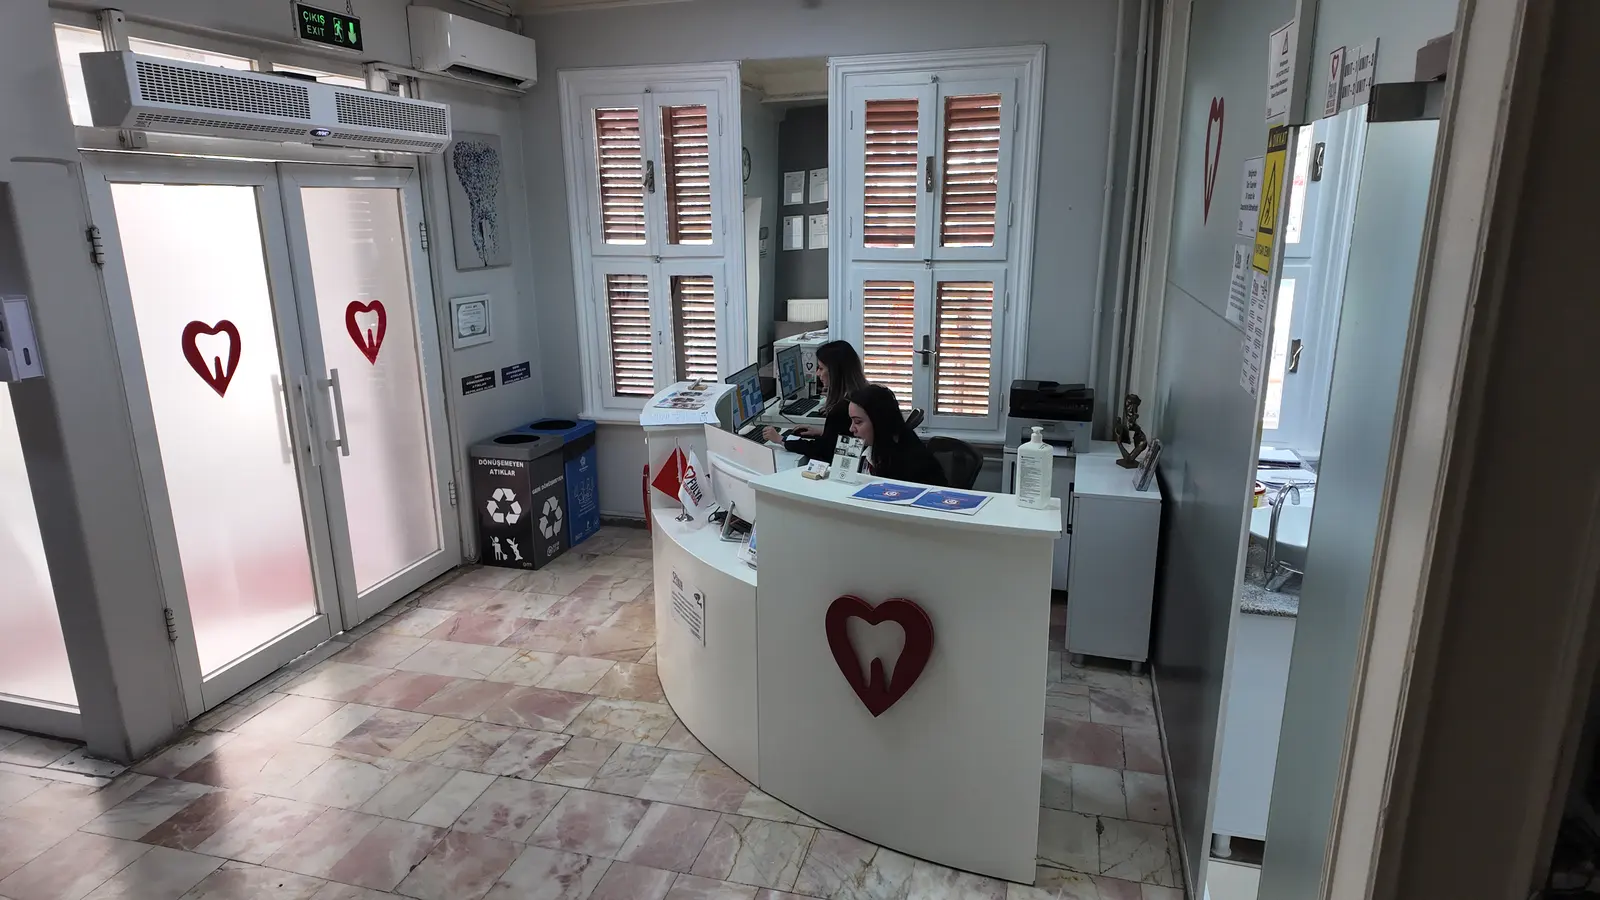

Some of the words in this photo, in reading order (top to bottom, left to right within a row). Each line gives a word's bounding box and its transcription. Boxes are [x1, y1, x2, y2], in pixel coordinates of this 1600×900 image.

[307, 24, 325, 37] EXIT
[478, 459, 524, 468] DÖNÜŞEMEYEN
[489, 468, 516, 477] ATIKLAR
[687, 476, 703, 503] FULYA
